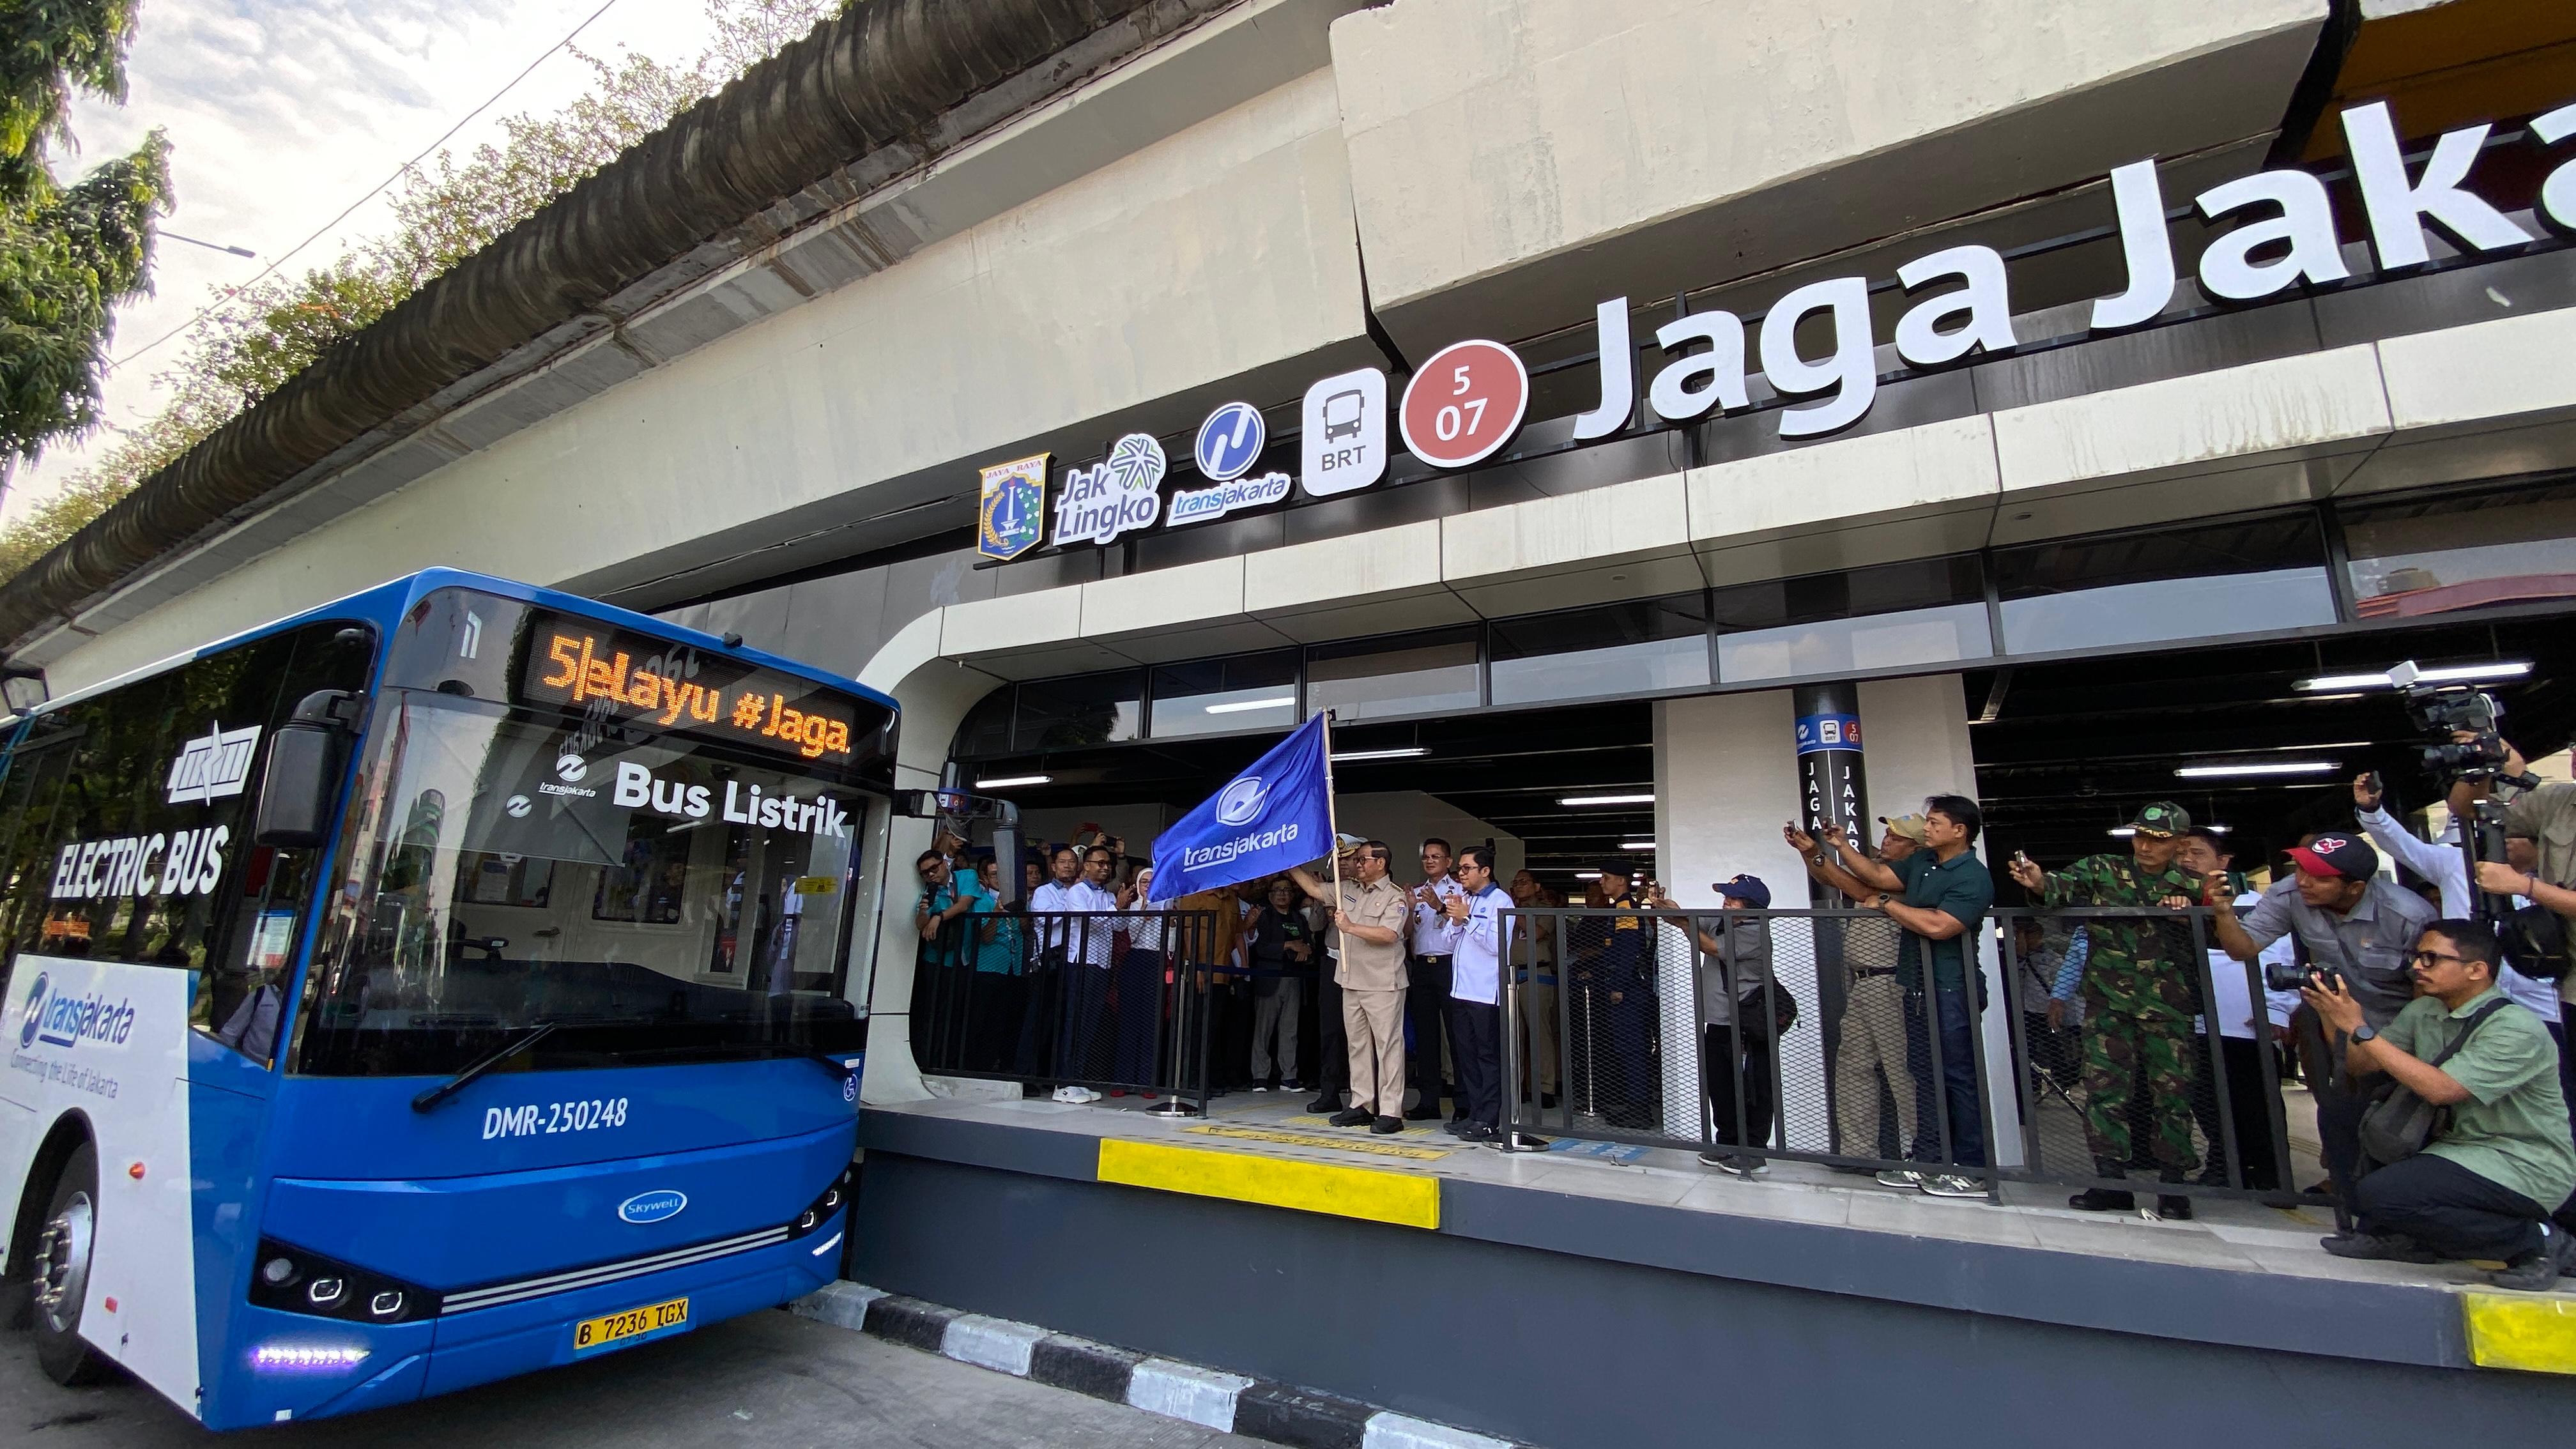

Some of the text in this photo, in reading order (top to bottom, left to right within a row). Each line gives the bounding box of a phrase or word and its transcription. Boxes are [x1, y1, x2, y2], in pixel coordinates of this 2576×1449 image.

[1574, 244, 2018, 440] Jaga
[1453, 365, 1471, 395] 5
[1436, 397, 1488, 441] 07
[986, 459, 1043, 480] JAYA RAYA
[1322, 445, 1366, 471] BRT
[1061, 469, 1110, 506] Jak
[1174, 479, 1286, 519] transjakarta
[1058, 494, 1154, 539] Lingko
[1849, 733, 1859, 742] 07
[538, 781, 596, 798] transjakarta
[613, 762, 848, 839] Bus Listrik
[1809, 762, 1822, 831] JAGA
[51, 825, 229, 898] ELECTRIC BUS
[1183, 823, 1298, 873] transjakarta
[39, 987, 135, 1048] transjakarta
[86, 1070, 119, 1099] Jakarta
[482, 1098, 628, 1140] DMR-250248
[579, 1300, 687, 1345] B 7236 TGX
